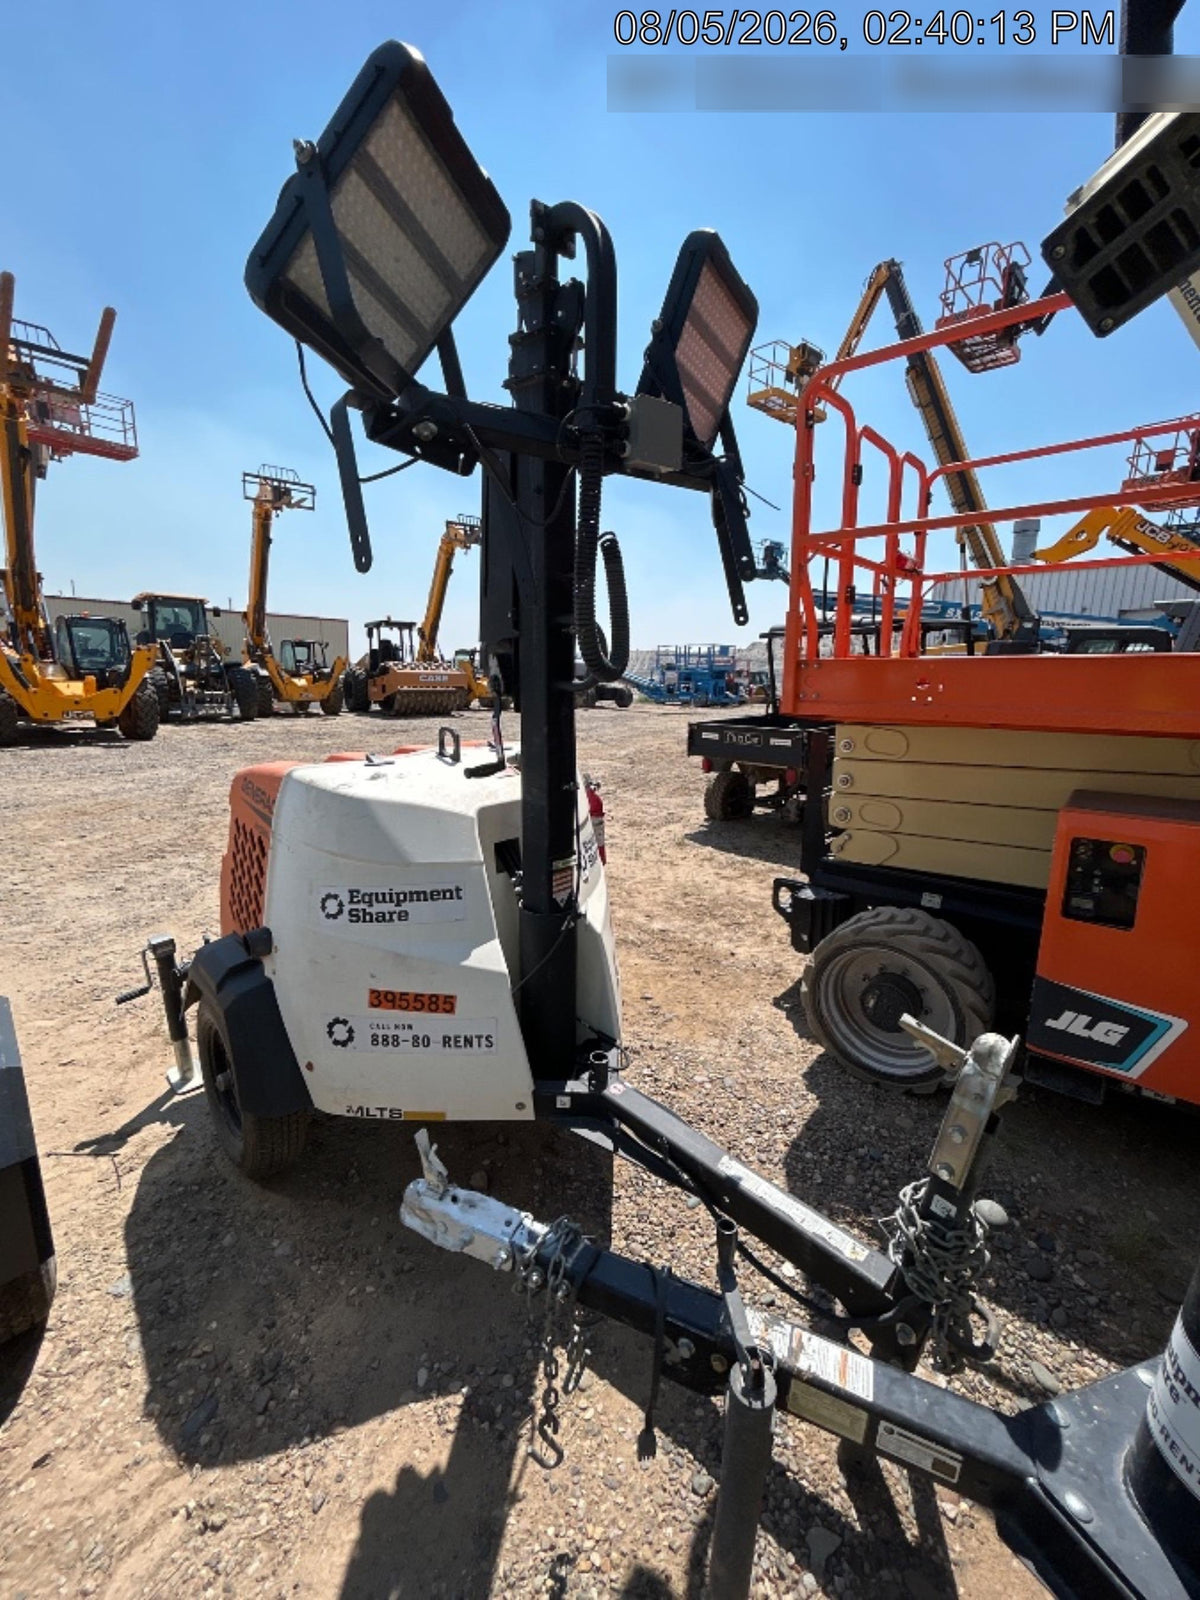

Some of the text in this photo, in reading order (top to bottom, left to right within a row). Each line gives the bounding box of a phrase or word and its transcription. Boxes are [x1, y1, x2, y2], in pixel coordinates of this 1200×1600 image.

[1135, 521, 1171, 544] JCB
[347, 885, 463, 908] Equipment
[347, 907, 410, 924] Share
[369, 989, 455, 1014] 395585
[1045, 1010, 1130, 1047] JLG
